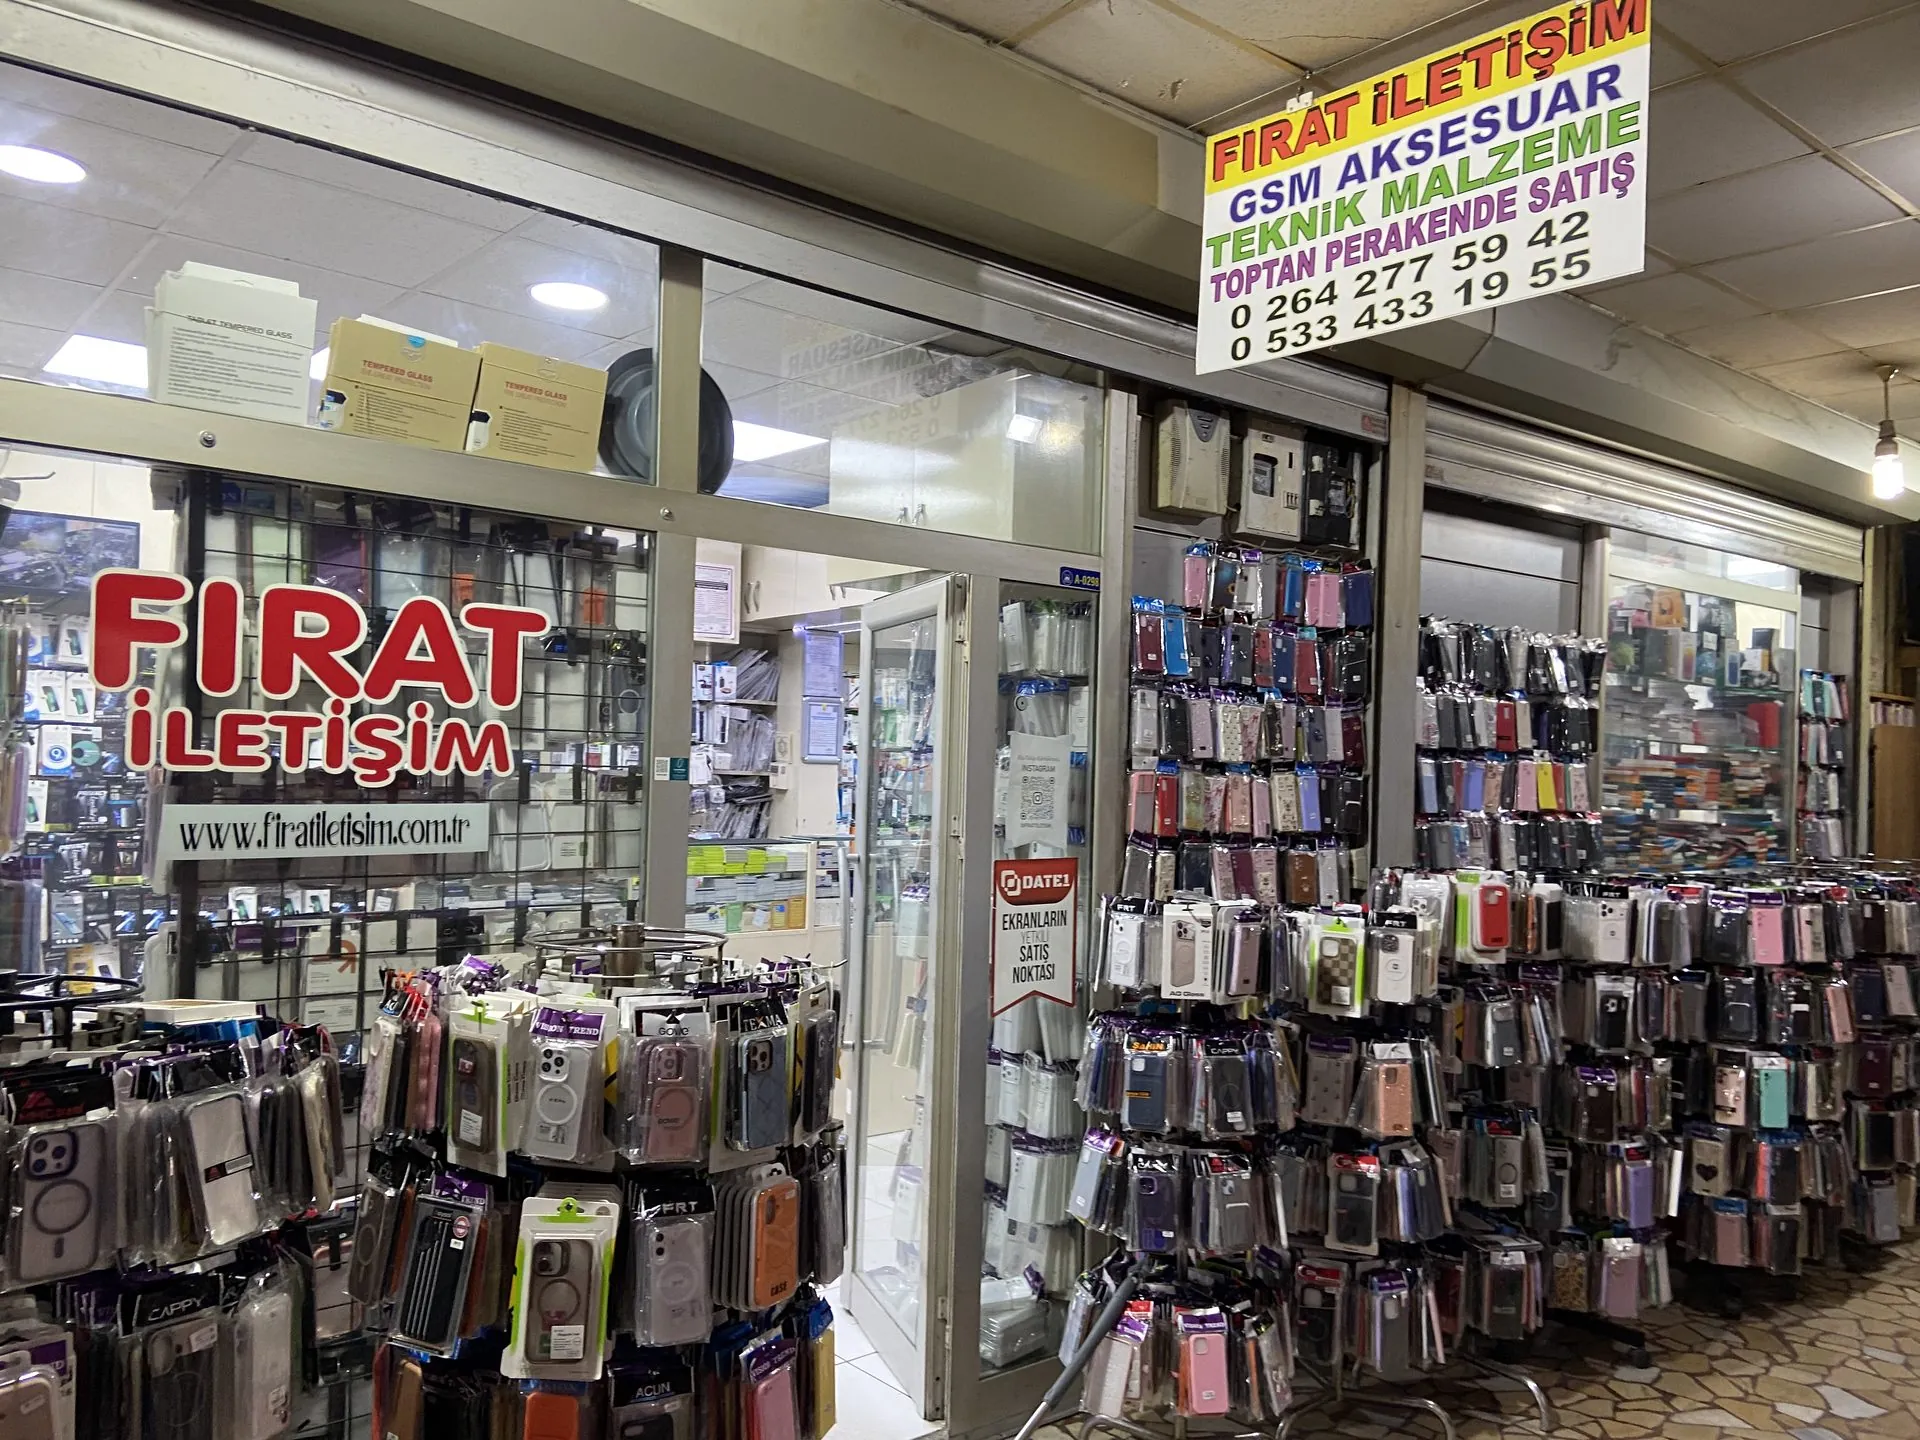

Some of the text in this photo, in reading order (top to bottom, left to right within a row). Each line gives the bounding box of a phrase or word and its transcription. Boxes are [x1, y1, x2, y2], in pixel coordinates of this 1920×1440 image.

[1212, 92, 1359, 182] FIRAT
[1229, 64, 1622, 223] GSM AKSESUAR
[1381, 101, 1641, 218] MALZEME
[1211, 151, 1635, 302] TOPTAN PERAKENDE SATIŞ
[1231, 211, 1589, 330] 0 264 277 59 42
[1231, 249, 1591, 361] 0 533 433 19 55
[219, 320, 264, 335] TEMPERED
[265, 328, 293, 340] GLASS
[362, 359, 433, 383] TEMPERED GLASS
[505, 381, 543, 396] TEMPERED
[544, 389, 568, 401] GLASS
[90, 567, 552, 711] FIRAT
[124, 687, 515, 788] İLETİŞİM
[1022, 764, 1056, 773] INSTAGRAM
[179, 811, 471, 851] www.firatiletisim.com.tr
[1022, 873, 1071, 890] DATE1
[1117, 903, 1136, 912] FRT
[1002, 910, 1068, 931] EKRANLARIN
[1020, 944, 1050, 964] SATIŞ
[1012, 963, 1056, 984] NOKTASI
[535, 1021, 599, 1036] VISION TREND
[743, 1014, 783, 1032] TEXMA
[1210, 1047, 1240, 1055] CAPPY
[662, 1200, 699, 1214] FRT
[770, 1281, 787, 1297] CASE
[148, 1298, 206, 1322] CAPPY
